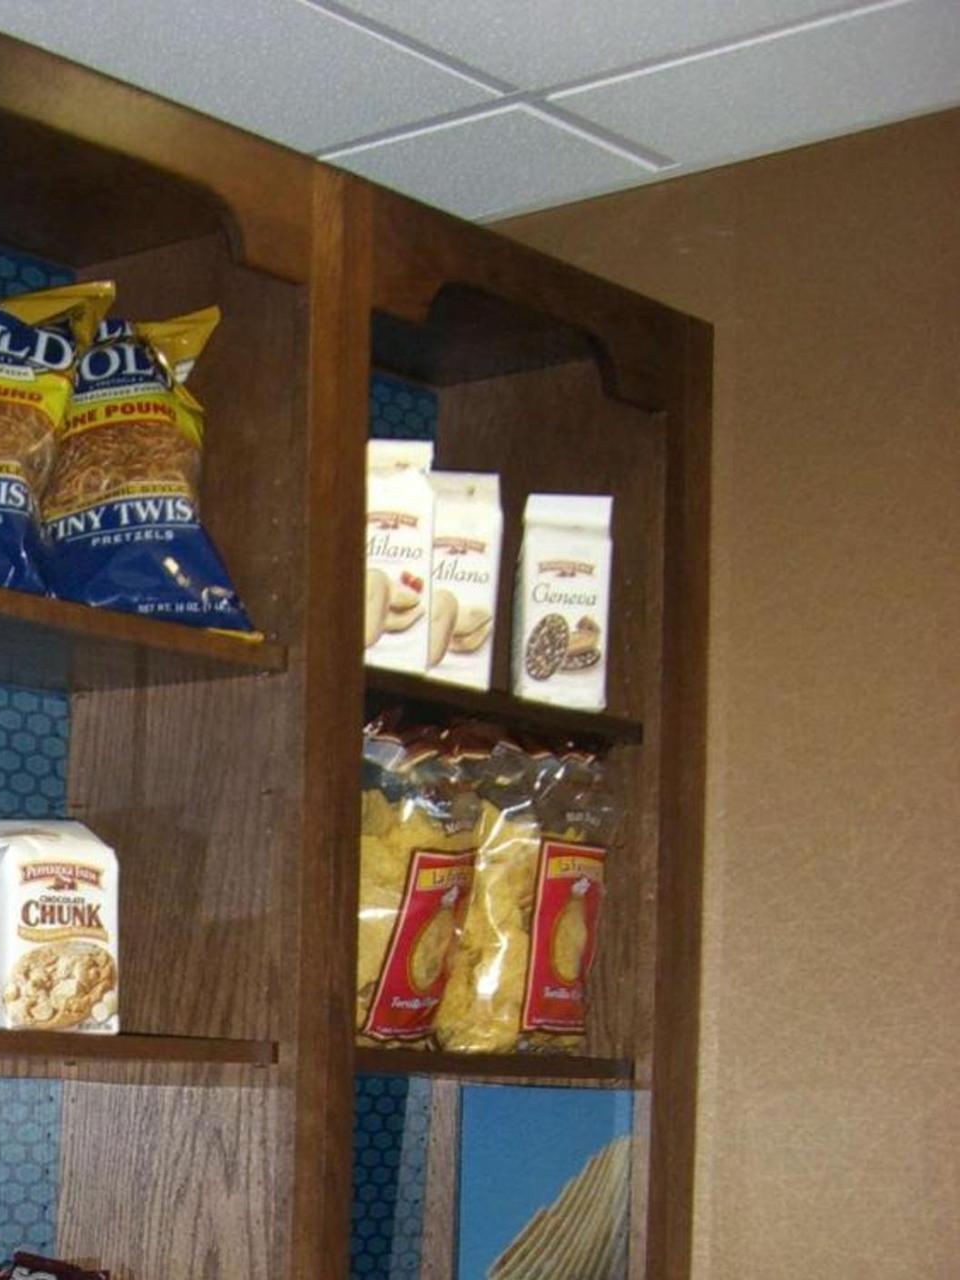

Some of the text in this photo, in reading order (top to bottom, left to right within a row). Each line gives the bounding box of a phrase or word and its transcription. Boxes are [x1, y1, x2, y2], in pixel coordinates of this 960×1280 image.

[41, 498, 200, 541] TINY TWIS
[91, 529, 175, 547] PRETZELS
[531, 583, 598, 608] Geneva
[39, 894, 86, 905] CHOCOLATE
[21, 900, 105, 928] CHUNK
